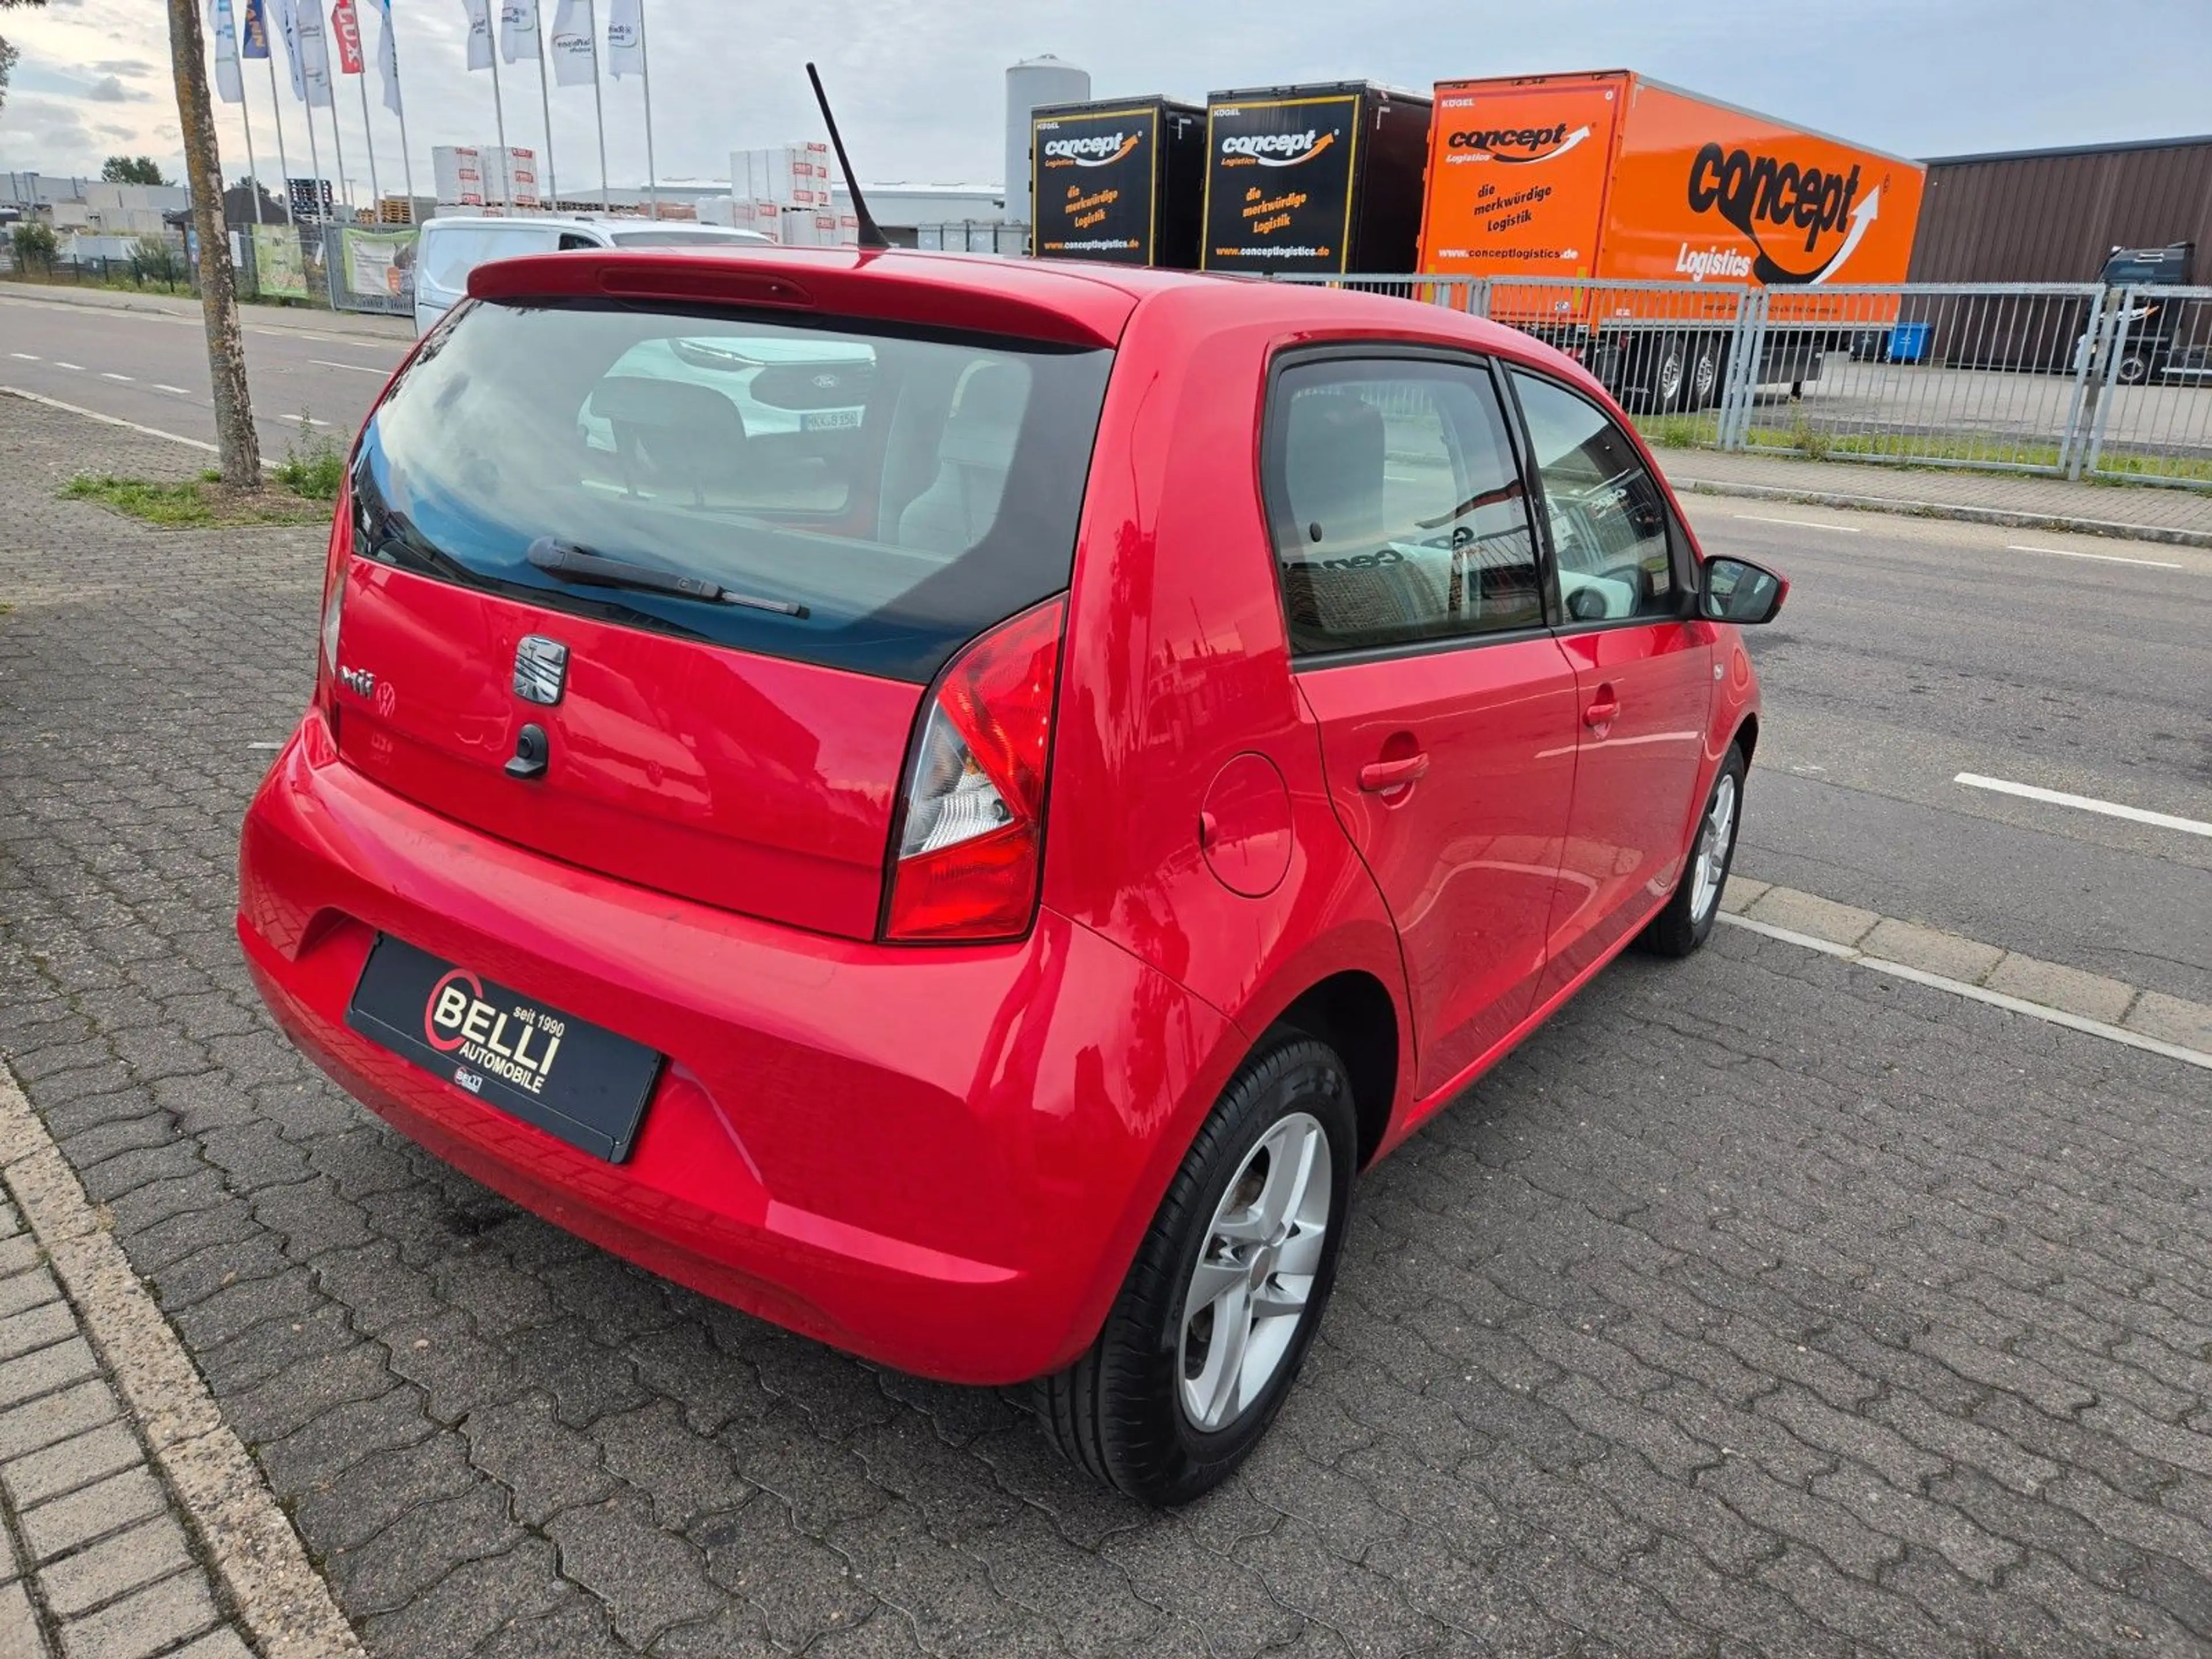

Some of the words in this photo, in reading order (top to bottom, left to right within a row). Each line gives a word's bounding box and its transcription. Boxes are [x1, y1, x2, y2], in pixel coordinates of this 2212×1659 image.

[1045, 132, 1123, 157] concept
[1222, 129, 1316, 156] concept
[1449, 123, 1566, 151] concept
[1246, 187, 1262, 202] die
[1474, 185, 1552, 216] merkwürdige
[1478, 183, 1495, 199] die
[1687, 142, 1861, 252] concept
[1242, 192, 1307, 218] merkwürdige
[1487, 209, 1532, 232] Logistik
[1215, 245, 1330, 258] www.conceptlogistics.de
[1438, 247, 1578, 260] www.conceptlogistics.de
[1675, 242, 1752, 282] Logistics
[434, 986, 560, 1075] BELLI
[513, 1006, 536, 1024] seit
[537, 1014, 565, 1037] 1990
[459, 1041, 545, 1094] AUTOMOBILE
